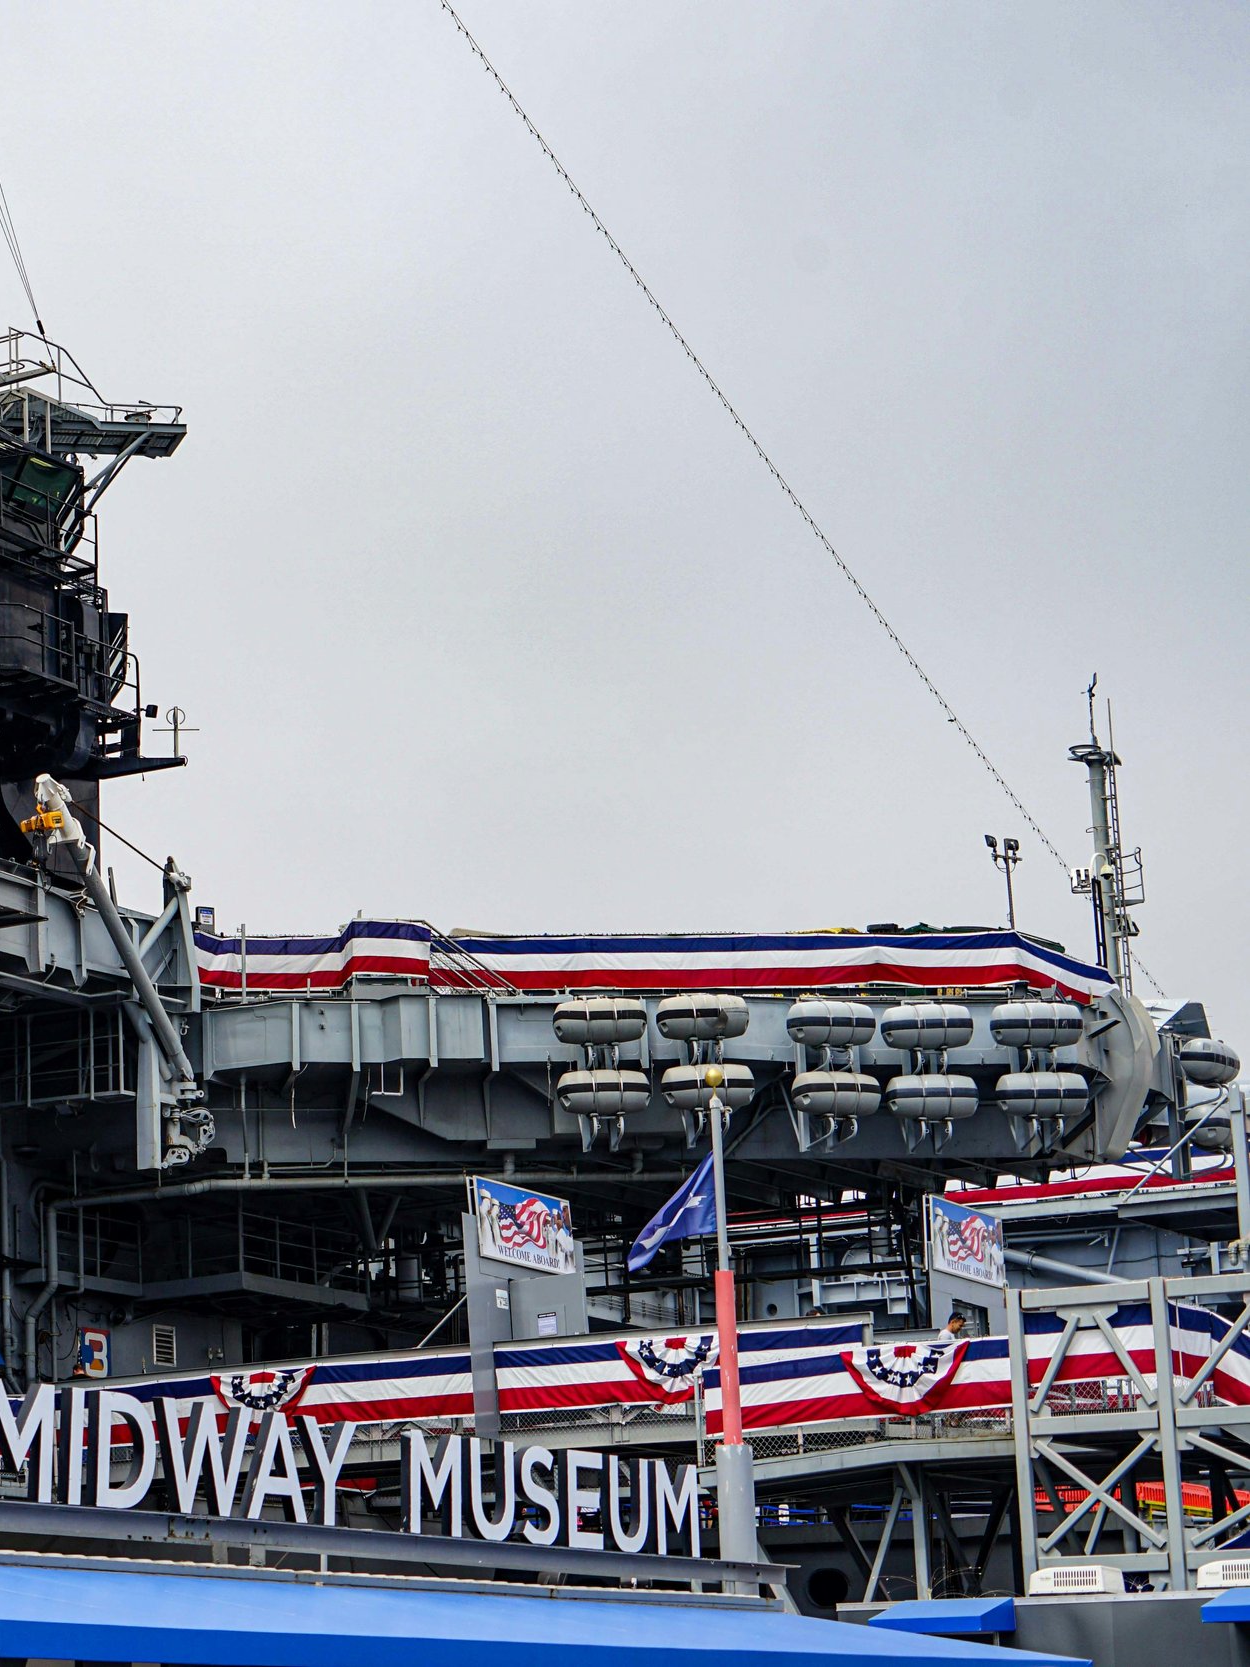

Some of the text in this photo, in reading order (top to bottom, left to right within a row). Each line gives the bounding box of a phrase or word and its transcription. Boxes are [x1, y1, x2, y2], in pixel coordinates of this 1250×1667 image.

[497, 1244, 531, 1263] WELCOME
[946, 1258, 971, 1275] WELCOME
[84, 1331, 108, 1378] 3
[402, 1428, 701, 1558] MUSEUM
